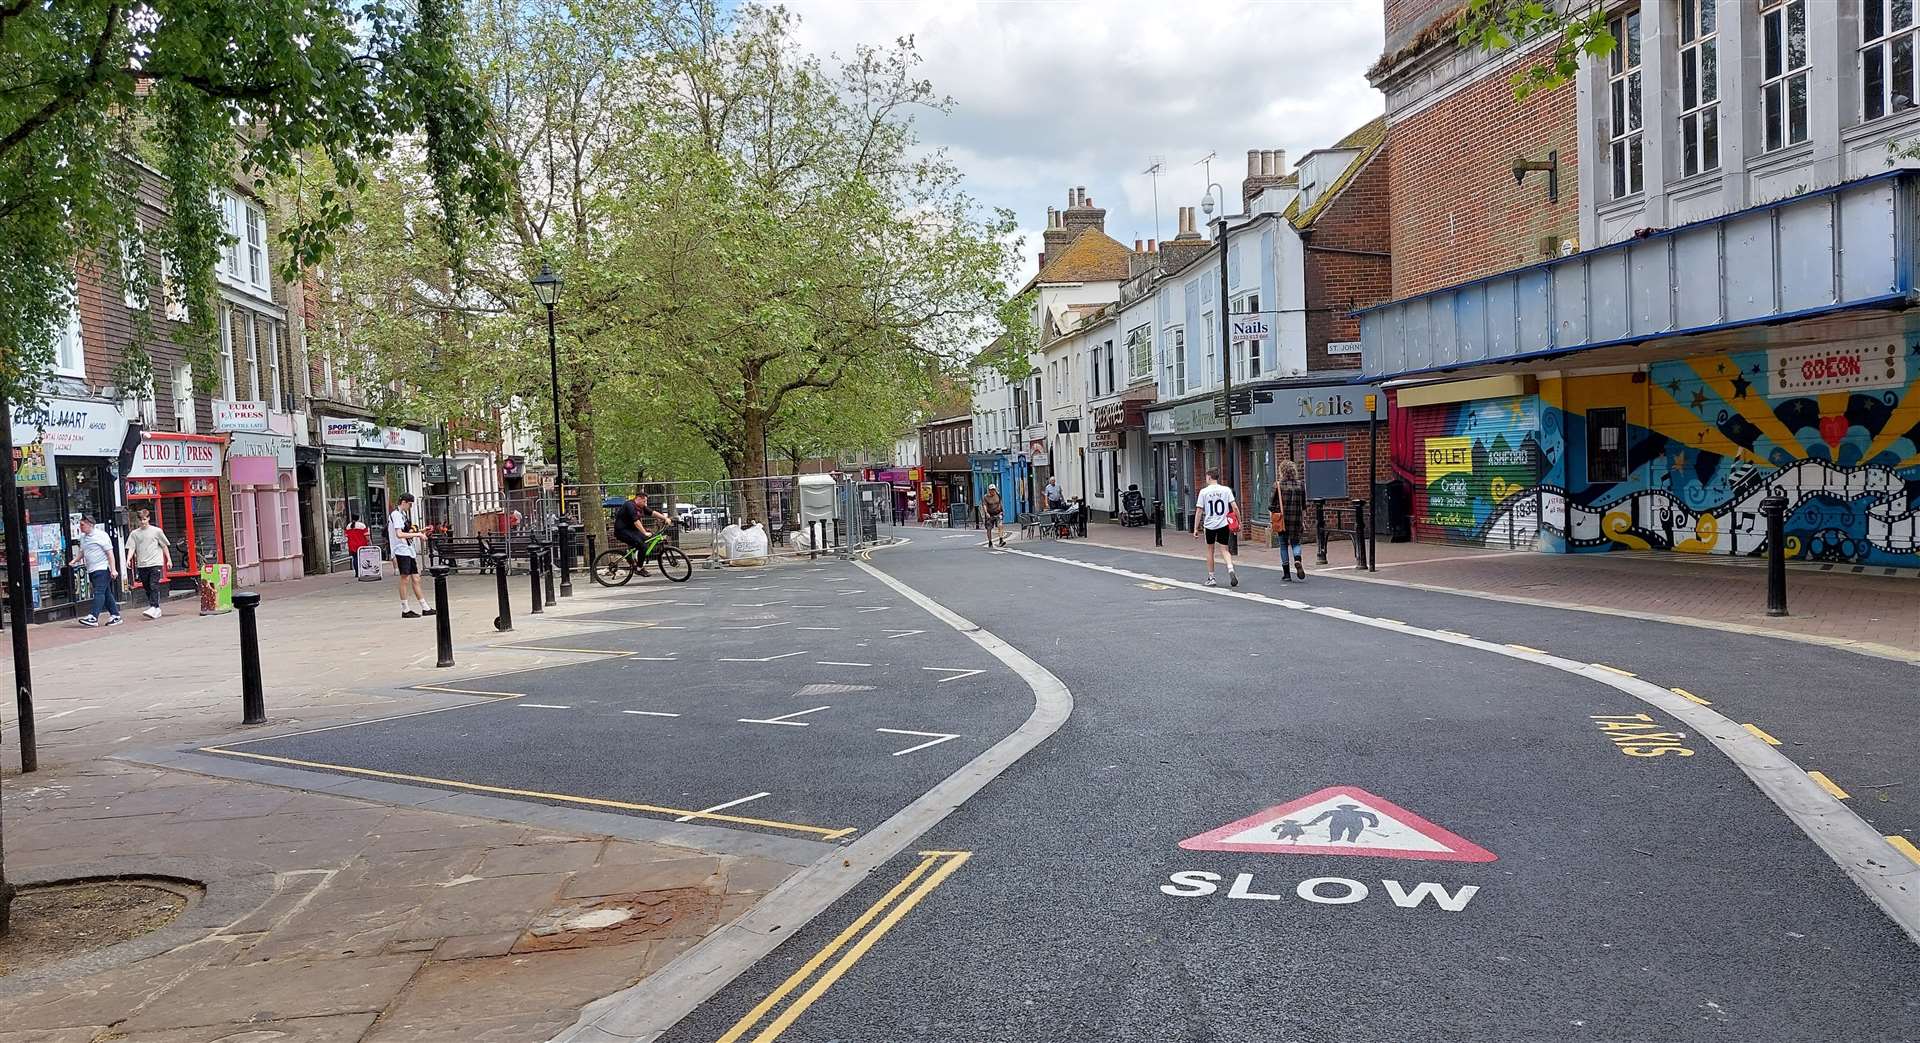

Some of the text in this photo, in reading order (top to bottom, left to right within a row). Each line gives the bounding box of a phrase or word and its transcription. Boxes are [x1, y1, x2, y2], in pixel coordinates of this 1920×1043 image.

[1234, 322, 1269, 334] Nails
[1802, 355, 1861, 380] ODEON
[1298, 393, 1354, 417] Nails
[14, 406, 88, 428] GLOBAL MART
[143, 441, 213, 465] EURO EXPRESS
[1428, 448, 1467, 465] TO LET
[1488, 450, 1529, 466] ASHFORD
[1208, 499, 1225, 516] 10
[1515, 498, 1537, 519] 1936
[1590, 713, 1694, 757] TAXIS
[1160, 870, 1481, 912] SLOW
